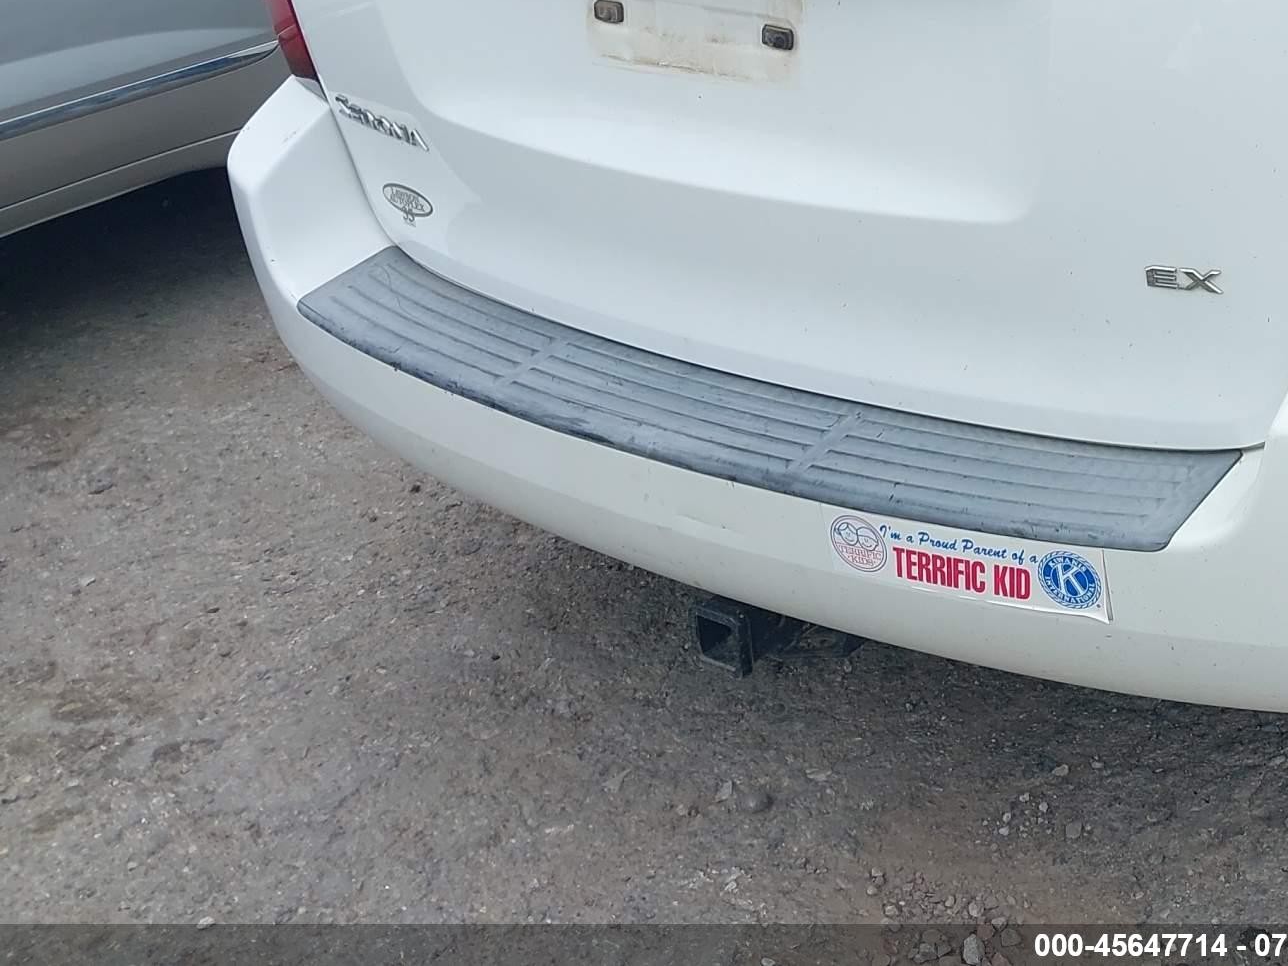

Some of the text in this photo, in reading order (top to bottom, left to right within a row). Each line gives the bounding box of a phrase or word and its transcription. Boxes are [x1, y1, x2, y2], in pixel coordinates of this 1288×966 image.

[1144, 265, 1224, 295] EX
[880, 524, 1039, 566] I'm a Proud Parent of a
[892, 546, 1031, 600] TERRIFIC KID
